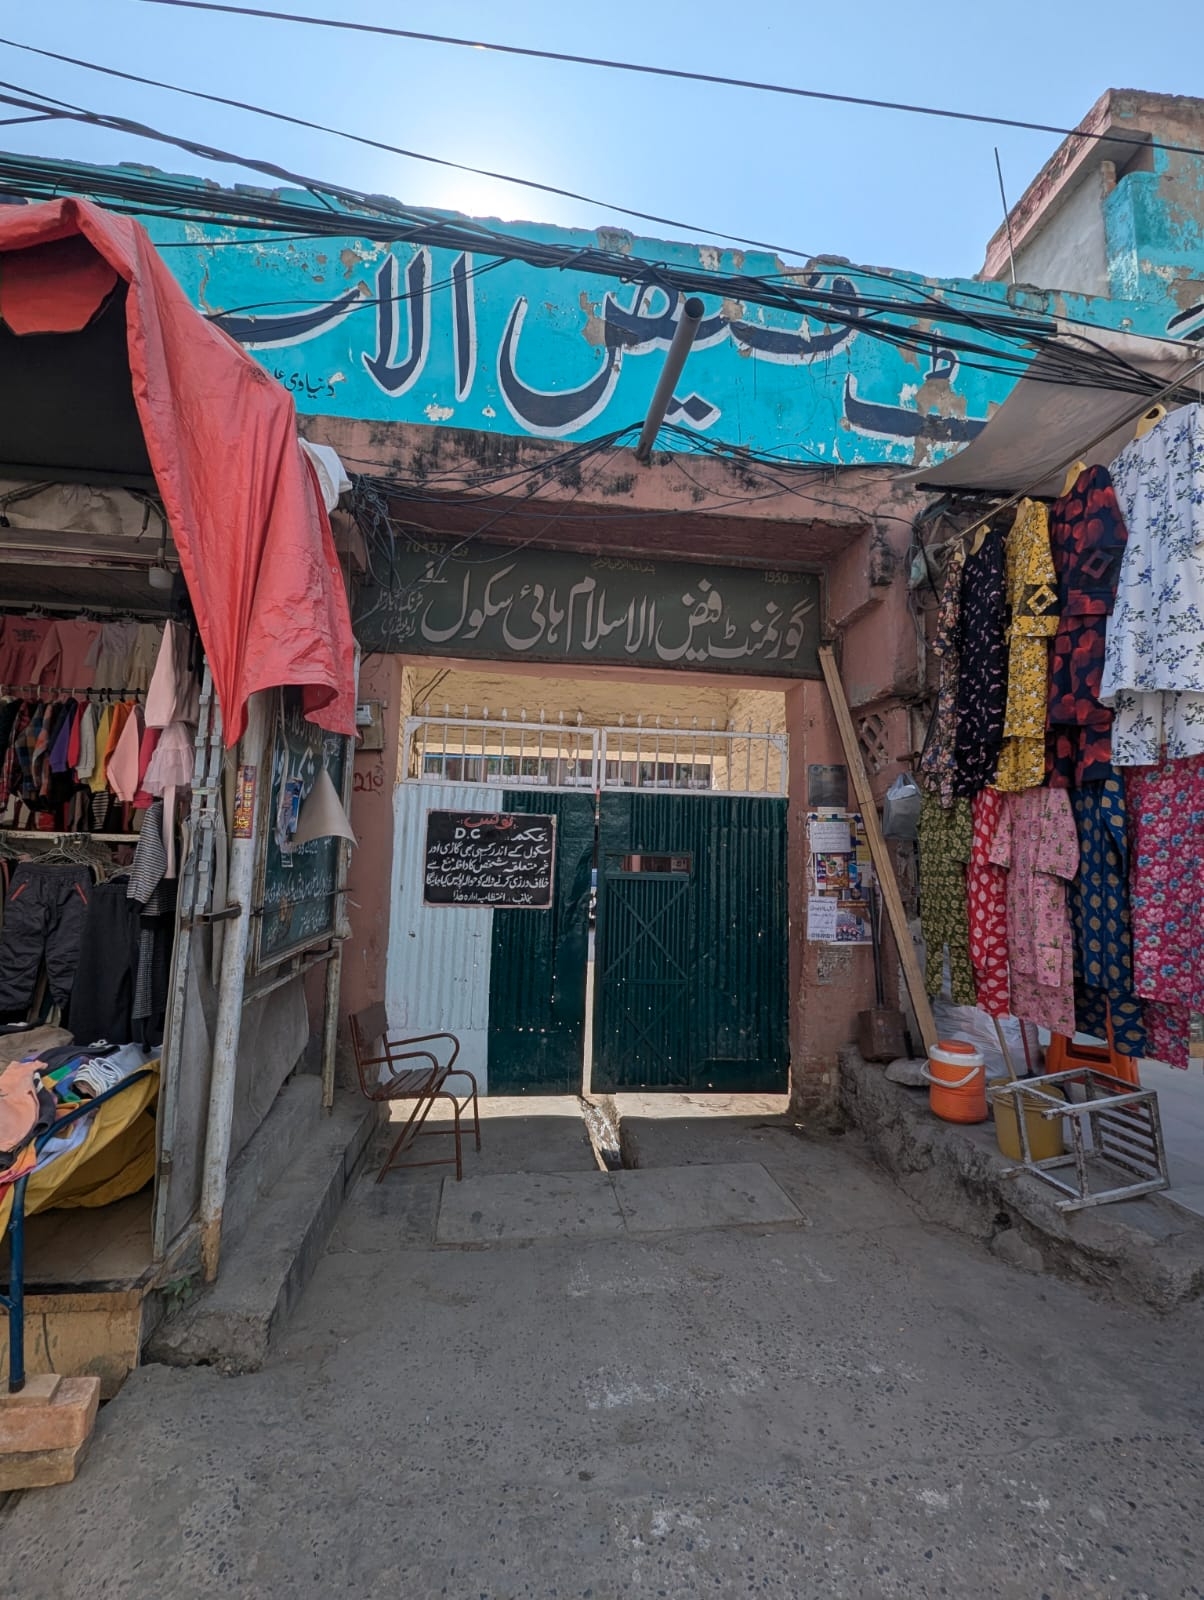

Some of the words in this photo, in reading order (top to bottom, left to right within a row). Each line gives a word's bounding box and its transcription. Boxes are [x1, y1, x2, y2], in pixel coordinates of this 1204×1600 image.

[420, 562, 518, 643] سکول
[565, 576, 657, 655] الاسلام
[655, 578, 723, 662] فیض
[707, 596, 815, 660] گورنمنٹ
[454, 827, 481, 839] D.C
[508, 844, 524, 858] کے
[523, 844, 551, 859] سکول
